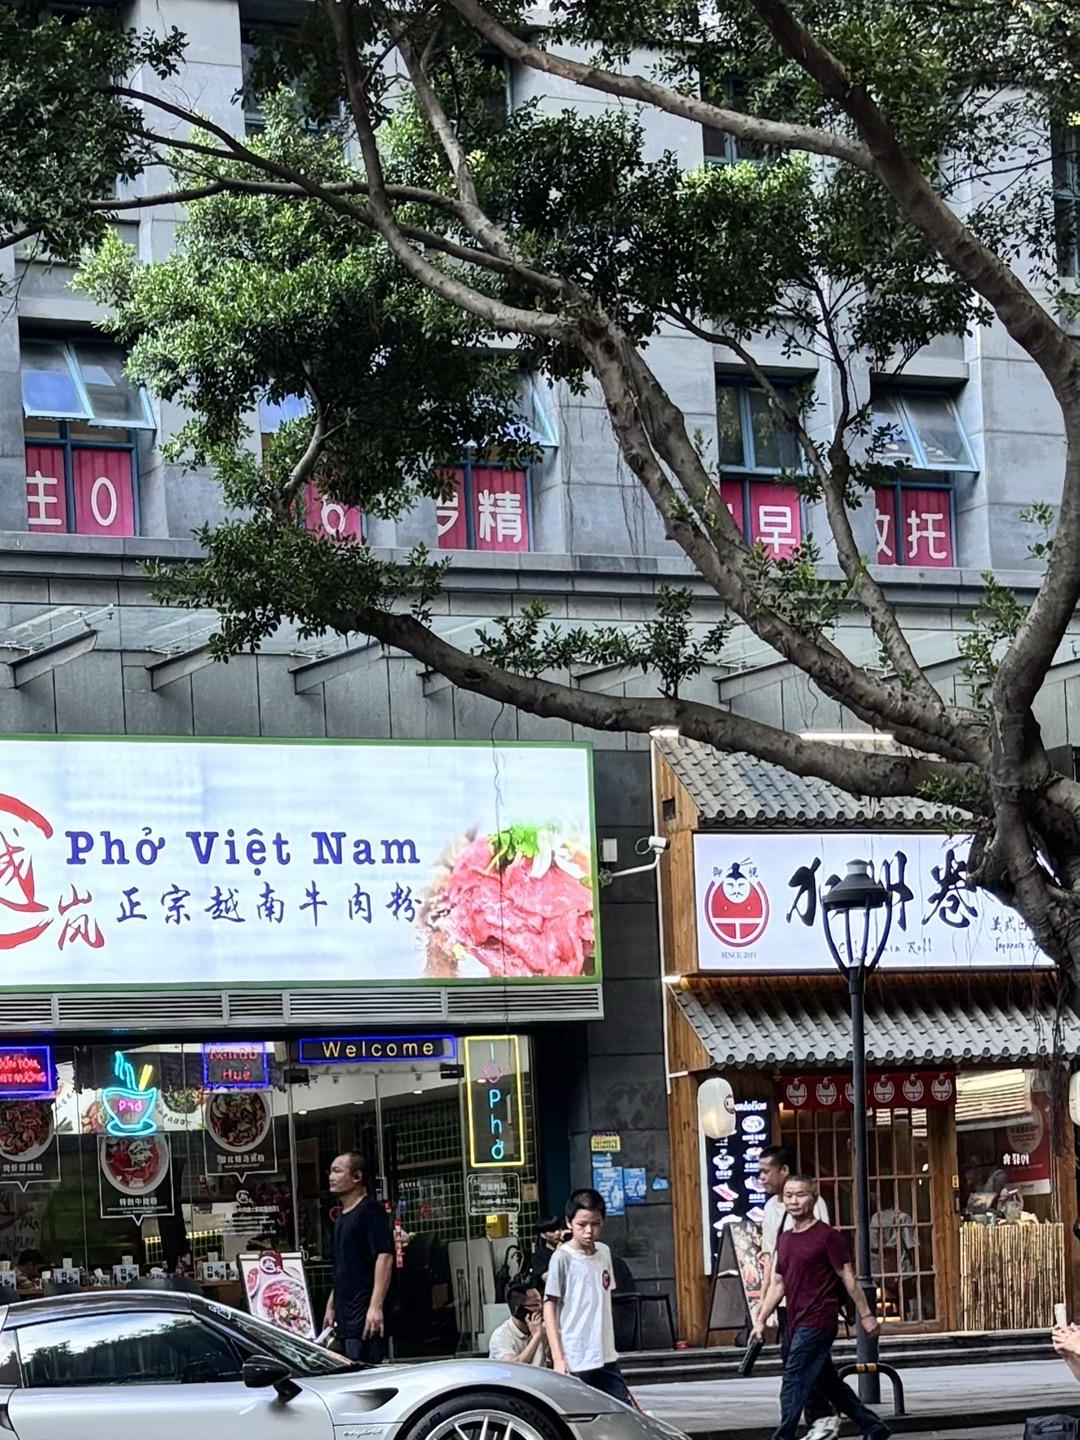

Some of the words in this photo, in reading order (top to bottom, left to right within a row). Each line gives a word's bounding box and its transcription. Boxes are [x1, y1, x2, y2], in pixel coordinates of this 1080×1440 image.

[65, 827, 165, 865] Phở
[186, 828, 291, 876] Việt
[311, 832, 420, 865] Nam
[116, 880, 422, 927] 正宗越南牛肉粉
[322, 1041, 434, 1058] Welcome
